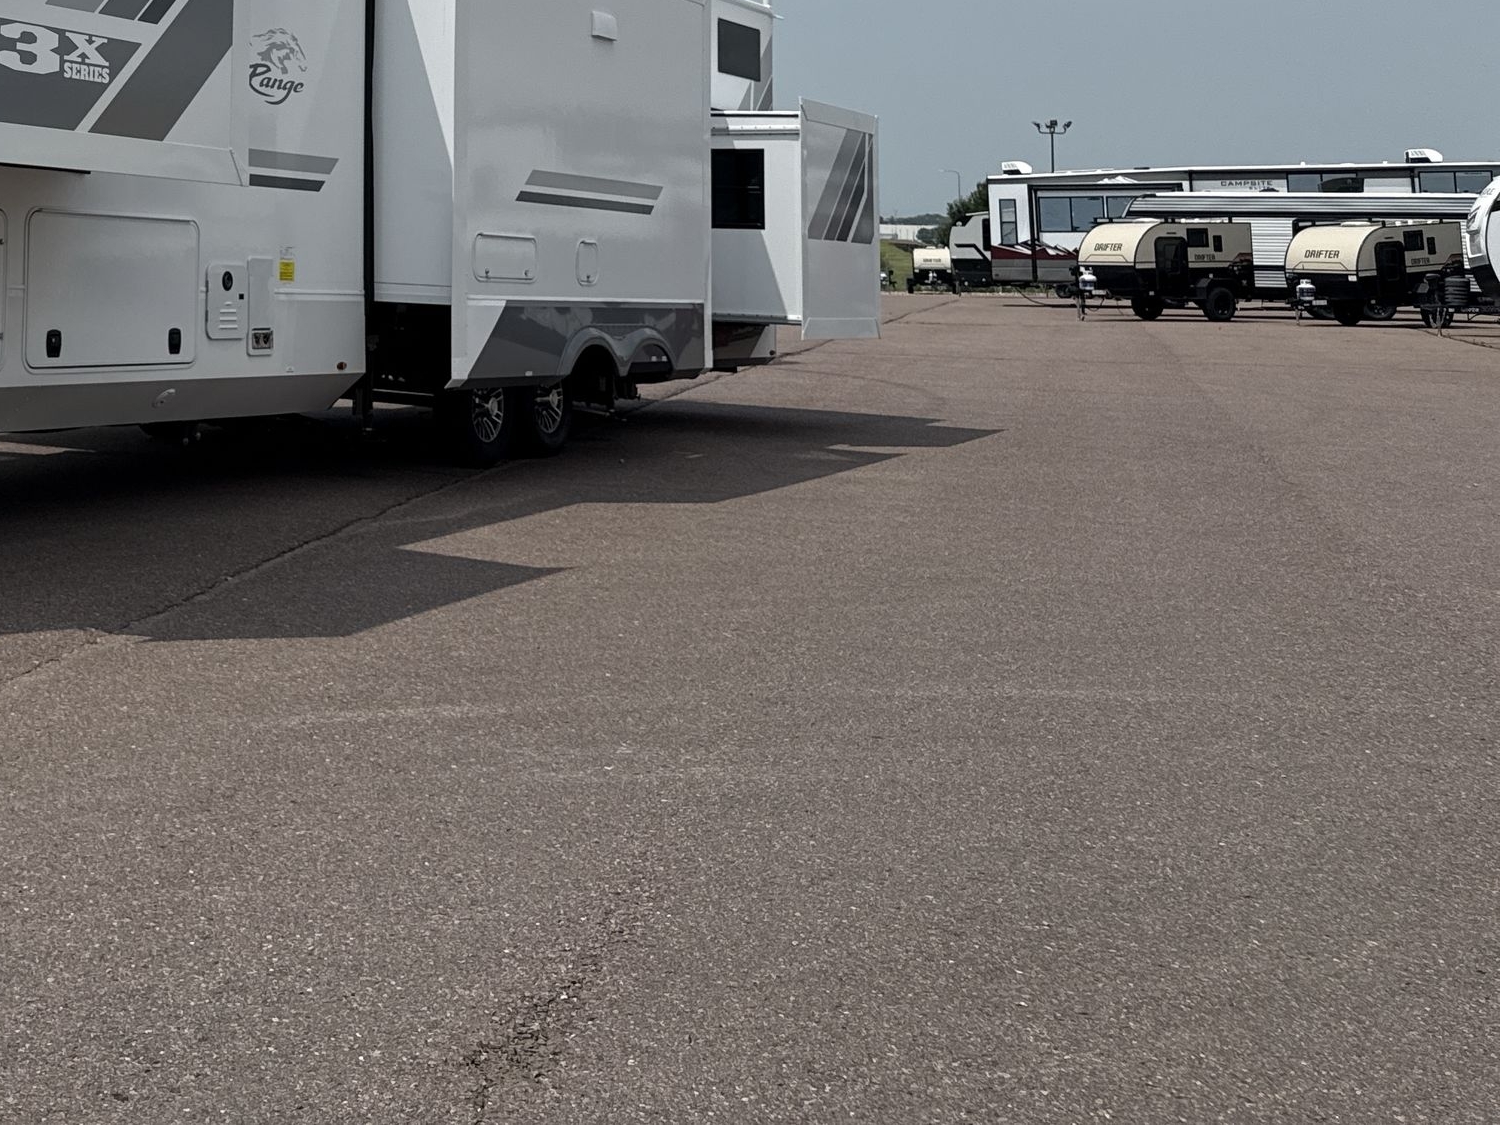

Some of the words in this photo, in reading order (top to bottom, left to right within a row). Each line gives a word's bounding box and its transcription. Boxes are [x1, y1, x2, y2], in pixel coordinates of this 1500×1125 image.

[63, 61, 110, 84] SERIES
[248, 62, 305, 106] Range
[1093, 242, 1123, 252] DRIFTER
[1303, 249, 1341, 259] DRIFTER
